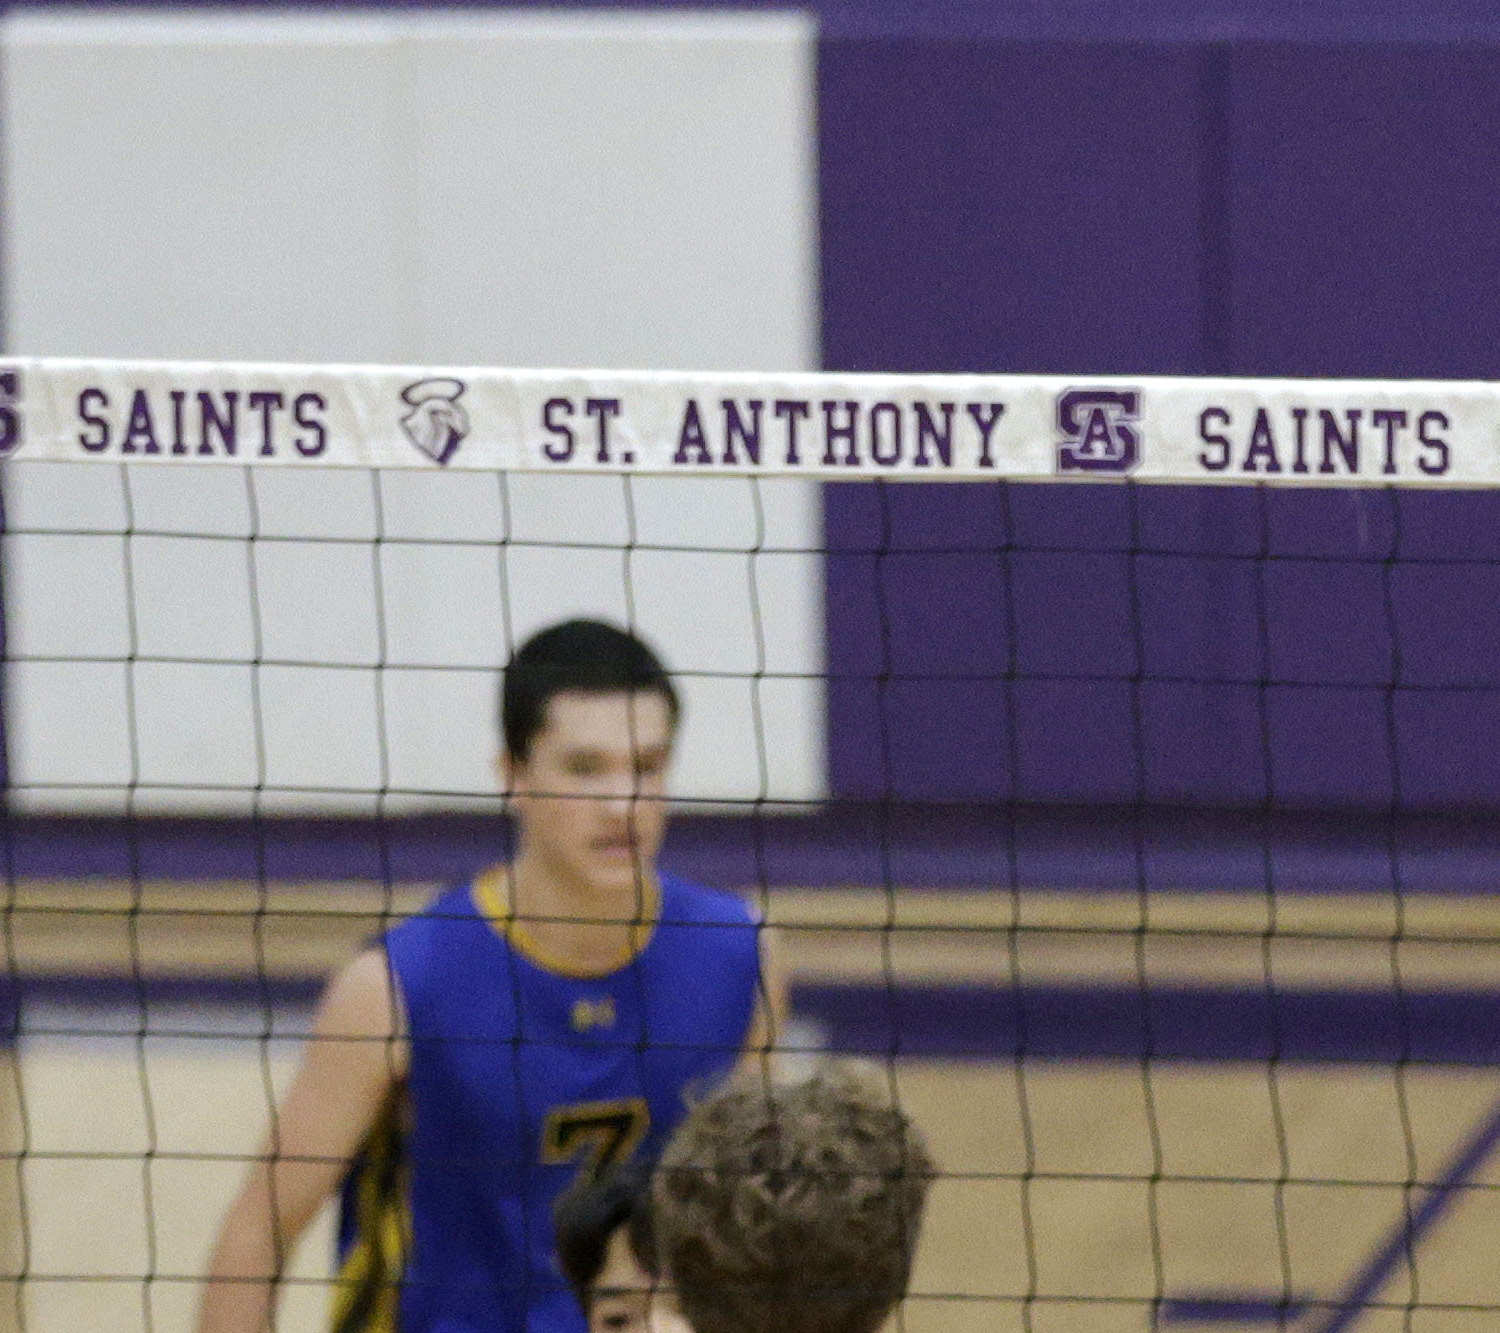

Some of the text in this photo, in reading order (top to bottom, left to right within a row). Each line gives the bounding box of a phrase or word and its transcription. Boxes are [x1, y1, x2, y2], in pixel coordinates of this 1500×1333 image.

[76, 386, 328, 459] SAINTS
[541, 396, 635, 466] ST.
[672, 397, 1006, 469] ANTHONY
[1197, 405, 1451, 477] SAINTS
[540, 1097, 651, 1190] 7
